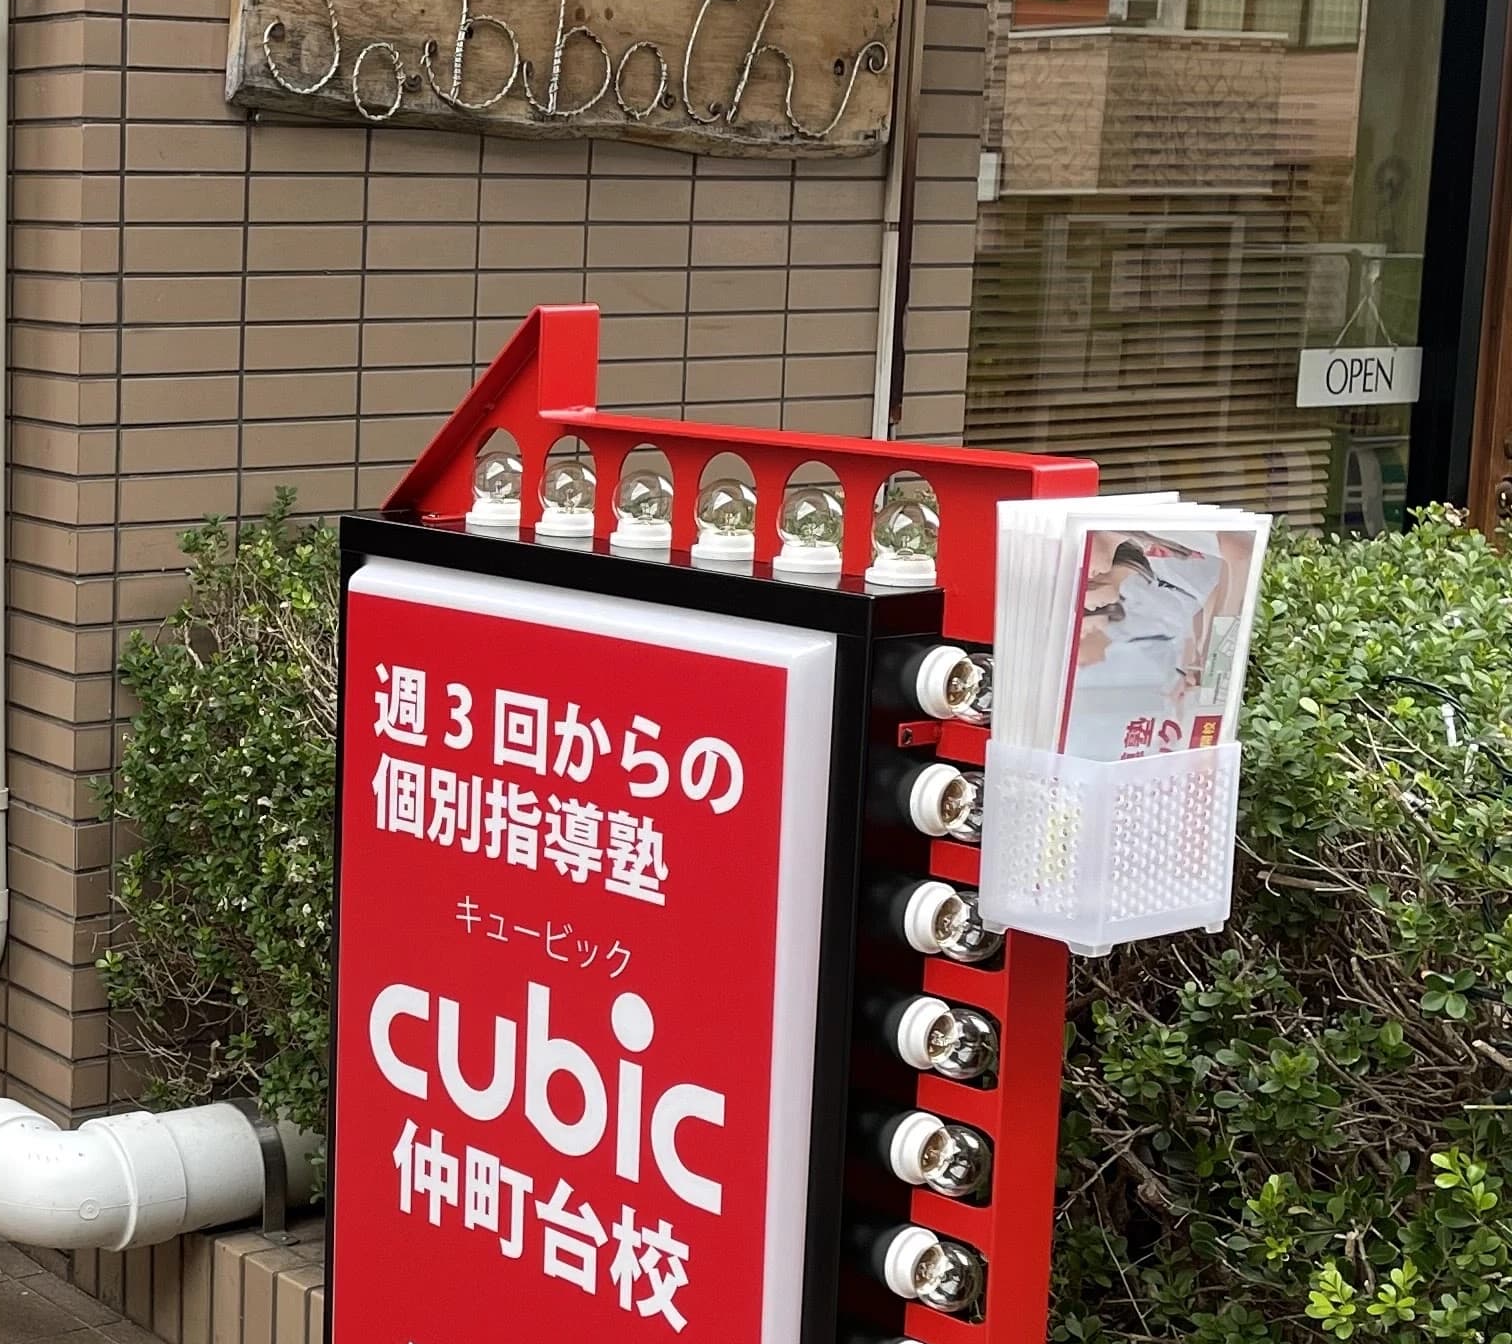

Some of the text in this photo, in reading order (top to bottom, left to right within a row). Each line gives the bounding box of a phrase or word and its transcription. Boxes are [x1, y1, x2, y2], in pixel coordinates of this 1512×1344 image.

[1326, 357, 1394, 396] OPEN
[371, 752, 669, 907] 個別指導塾
[455, 895, 631, 978] キュービック
[369, 981, 726, 1216] cubic
[392, 1118, 690, 1334] 仲町台校
